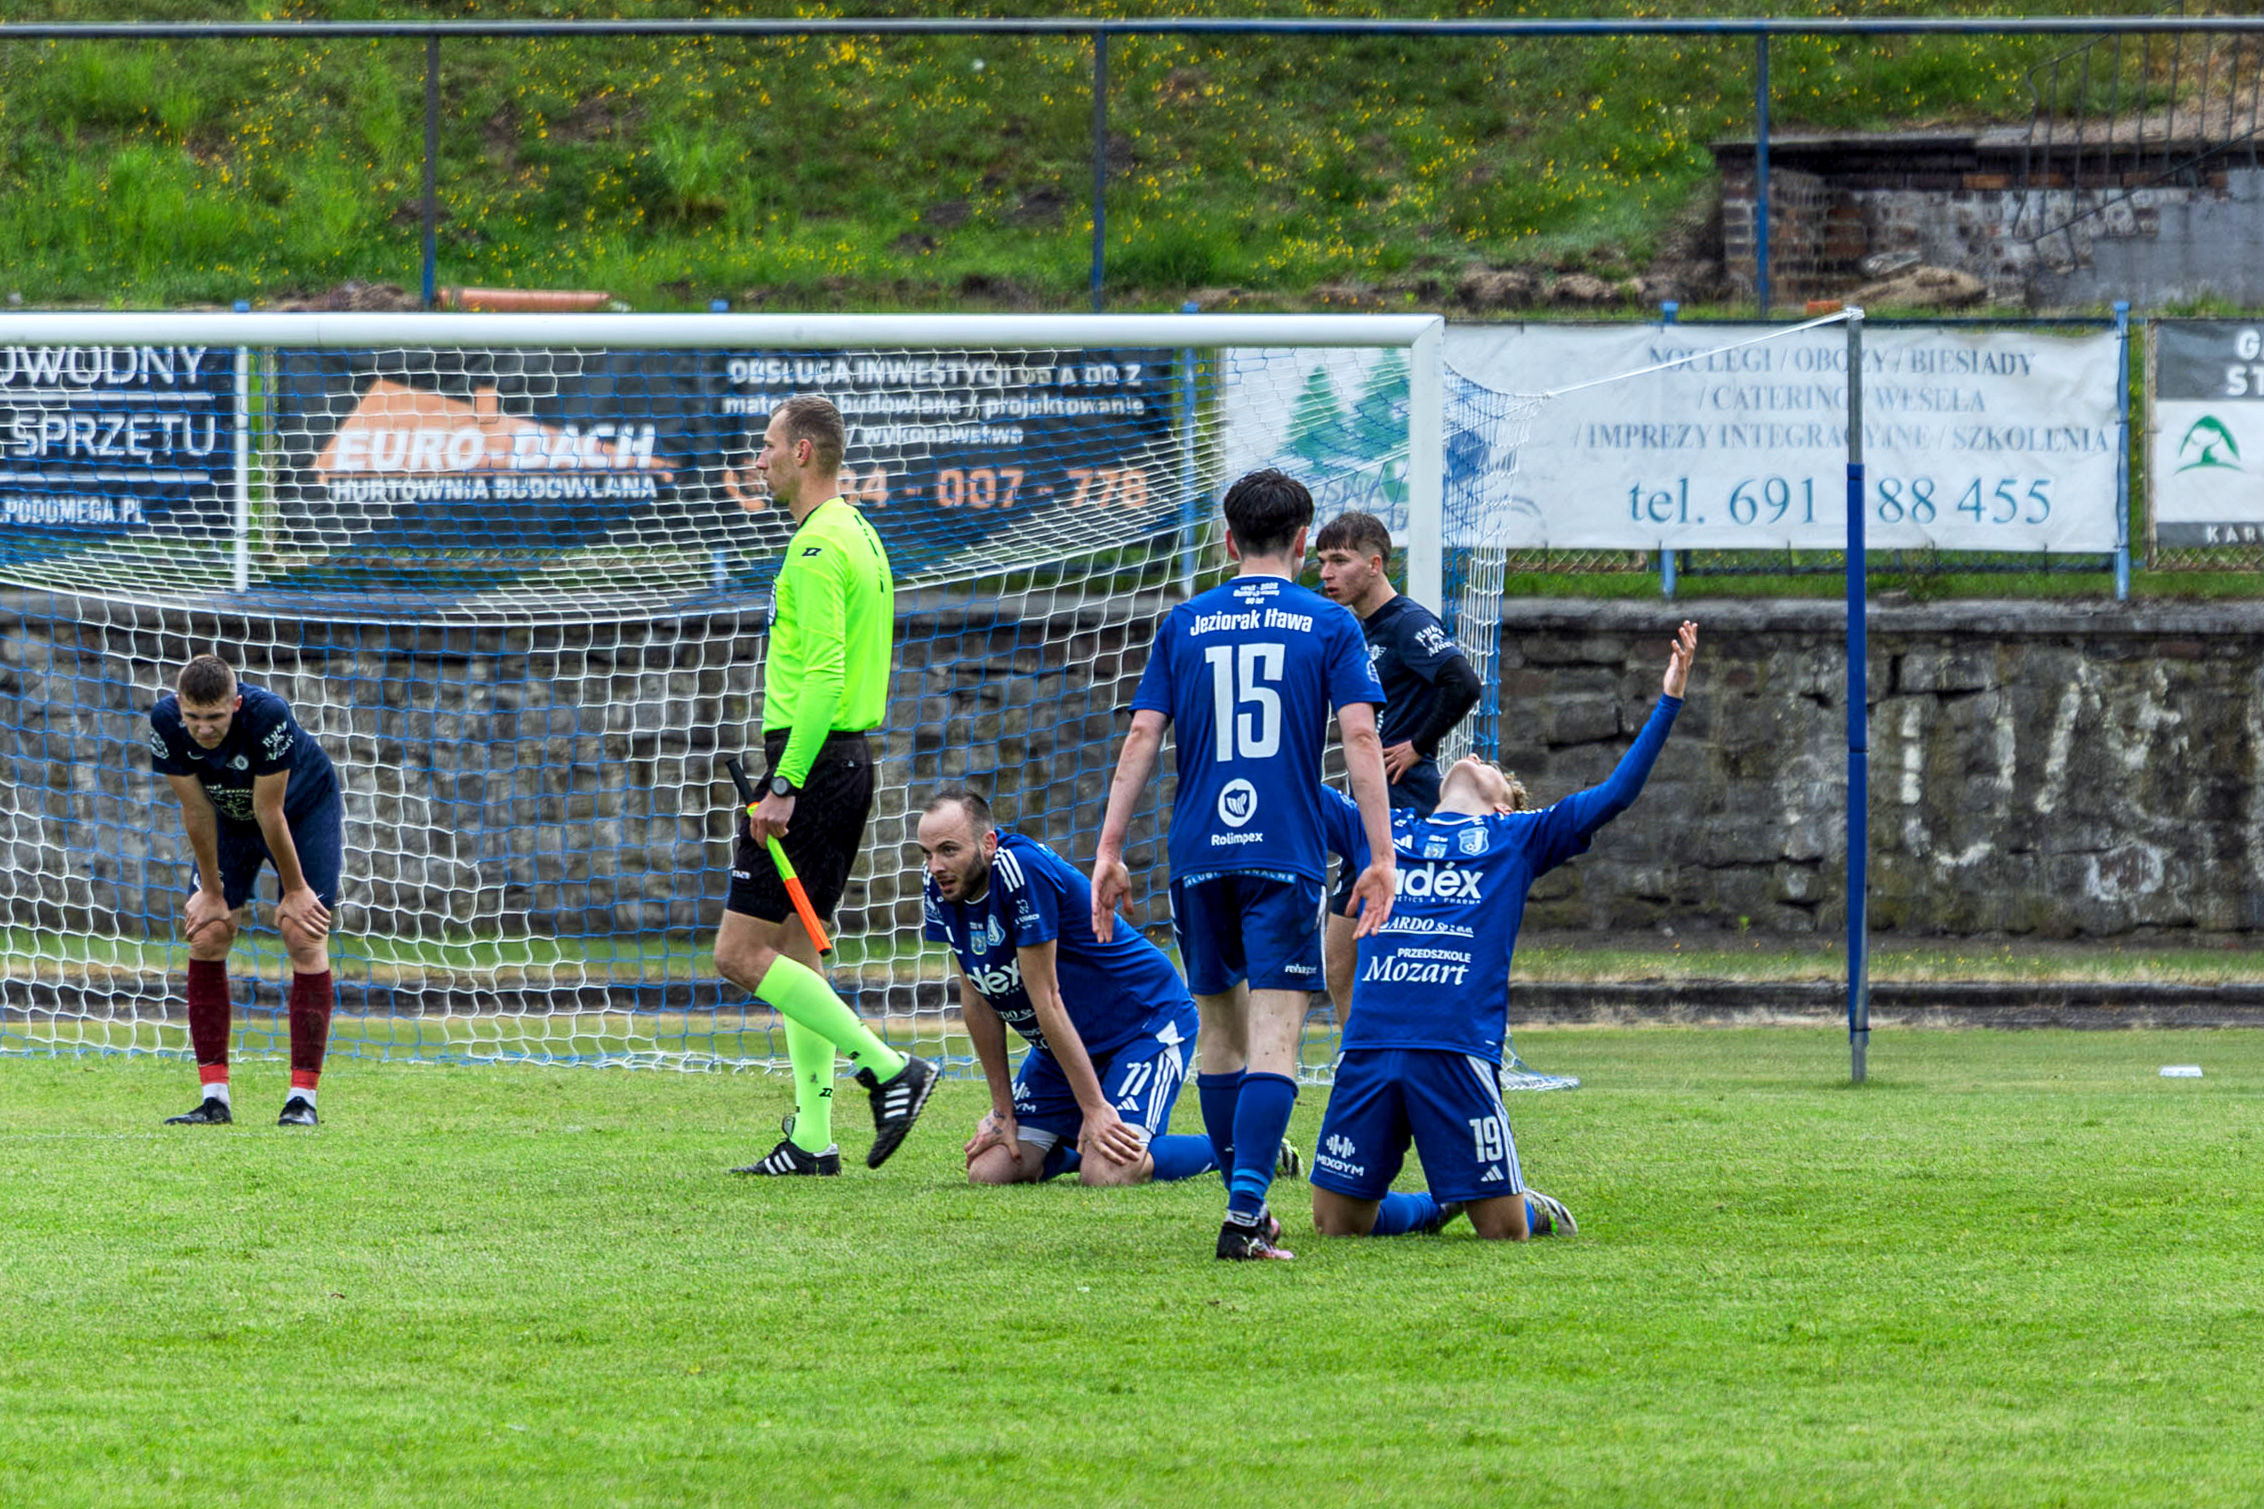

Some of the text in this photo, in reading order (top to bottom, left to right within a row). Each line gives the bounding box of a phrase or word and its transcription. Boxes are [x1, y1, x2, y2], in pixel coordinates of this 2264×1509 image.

[2238, 330, 2264, 361] G
[1124, 364, 1144, 386] Z
[1649, 347, 1771, 373] NOCLEGI
[1911, 348, 2036, 377] BIESIADY
[1876, 386, 1986, 412] WESELA
[10, 413, 216, 464] SPRZĘTU
[334, 423, 657, 471] EURO-DACH
[1588, 423, 1713, 449] IMPREZY
[1720, 423, 1931, 450] INTEGRAYJNE
[1952, 425, 2109, 452] SZKOLENIA
[332, 475, 658, 502] HURTOWNIA BUDOWLANA
[937, 469, 1024, 508] 007
[1629, 476, 1706, 525] tel.
[1728, 476, 1818, 526] 691
[1956, 476, 2052, 526] 455
[2206, 525, 2264, 545] KAR
[1190, 608, 1314, 637] Jeziorak Iława
[1205, 642, 1286, 763] 15
[1211, 832, 1264, 846] Rolimpex
[1398, 947, 1472, 964] PRZEDSZKOLE
[1361, 956, 1470, 986] Mozart
[1469, 1115, 1504, 1163] 19
